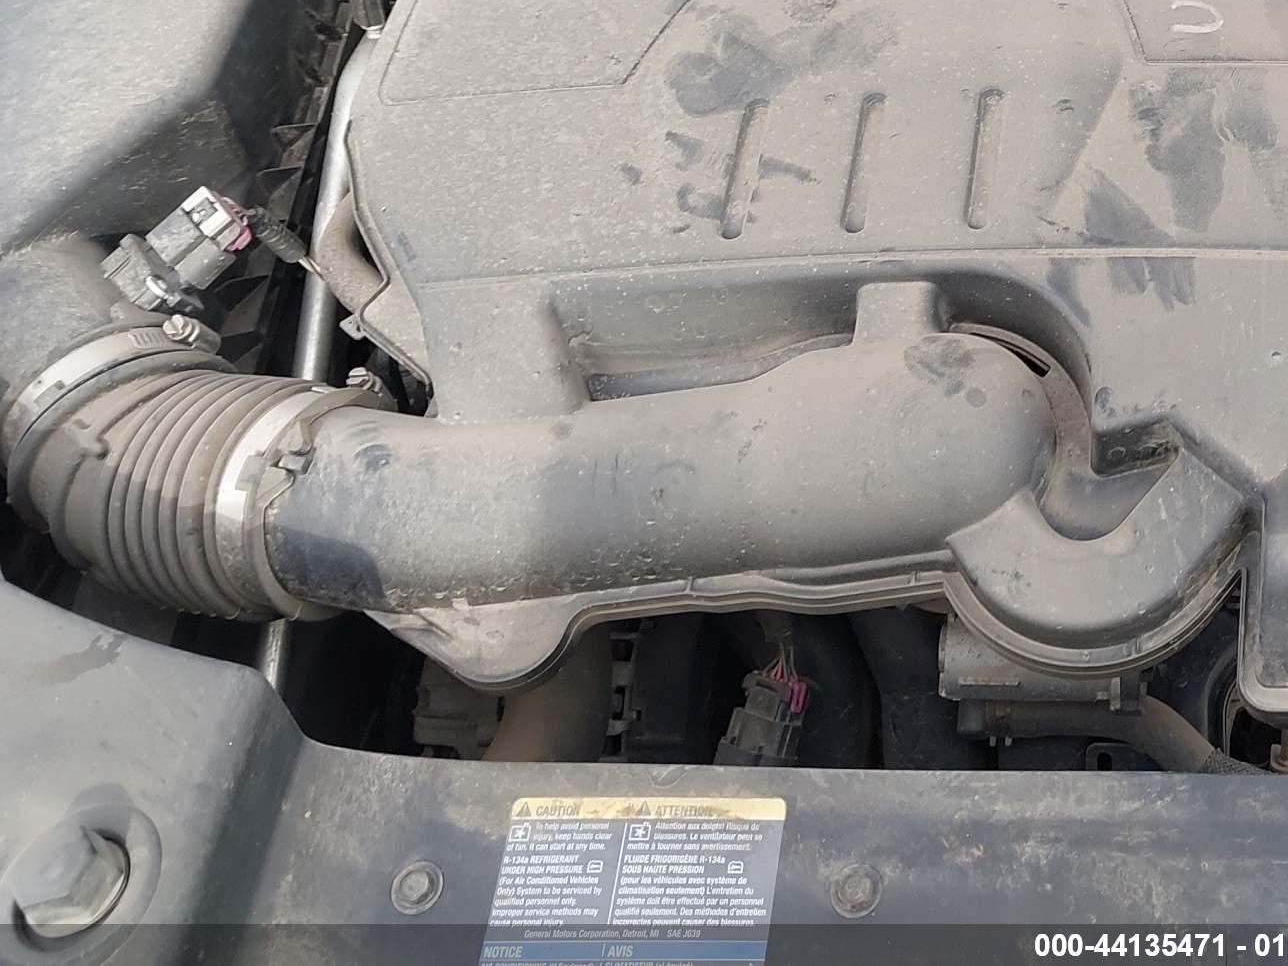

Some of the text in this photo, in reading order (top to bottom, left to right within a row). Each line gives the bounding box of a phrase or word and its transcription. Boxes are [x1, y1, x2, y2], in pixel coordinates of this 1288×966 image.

[535, 805, 581, 817] CAUTION
[655, 805, 714, 817] ATTENTION
[544, 822, 559, 832] help
[560, 822, 578, 830] avoid
[579, 822, 609, 832] personal
[655, 822, 686, 830] Attention
[726, 822, 749, 832] Risque
[750, 822, 760, 830] de
[554, 833, 571, 842] keep
[572, 832, 593, 840] hands
[594, 832, 613, 840] clear
[689, 833, 699, 841] Le
[699, 833, 736, 841] ventilateur
[737, 833, 753, 842] peut
[506, 842, 513, 851] of
[514, 842, 528, 851] fan.
[535, 843, 548, 851] can
[549, 842, 565, 851] start
[566, 842, 574, 851] at
[575, 844, 588, 852] any
[588, 842, 606, 850] time.
[626, 842, 650, 850] mettre
[650, 842, 656, 850] à
[657, 842, 683, 850] tourner
[701, 842, 752, 850] avertissement.
[503, 855, 580, 864] R-134a REFRIGERANT
[623, 854, 650, 863] FLUIDE
[699, 854, 726, 863] R-134a
[501, 865, 584, 874] UNDER HIGH PRESSURE
[622, 864, 705, 874] SOUS HAUTE PRESSION
[499, 876, 599, 885] (For Air Conditioned Vehicles
[620, 876, 640, 885] (pour
[641, 876, 652, 884] les
[653, 876, 687, 884] véhicules
[706, 876, 737, 886] système
[737, 876, 748, 884] de
[497, 887, 602, 897] Only) System to be serviced by
[618, 886, 754, 896] climatisation seulement) L'entretien du
[494, 897, 577, 906] qualified personnel only.
[616, 897, 645, 906] système
[646, 897, 661, 905] doit
[661, 897, 676, 905] être
[676, 896, 705, 905] effectué
[705, 898, 718, 906] par
[729, 897, 764, 906] personnel
[492, 908, 599, 917] Improper service methods may
[614, 907, 767, 916] qualifié seulement. Des méthodes d'entretien
[512, 919, 543, 927] personal
[613, 918, 652, 926] incorrectes
[652, 918, 681, 927] peuvent
[681, 918, 706, 926] causer
[706, 918, 719, 926] des
[523, 929, 702, 940] General Motors Corporation, Detroit, MI SAE J639
[483, 946, 524, 958] NOTICE
[607, 946, 634, 958] AVIS
